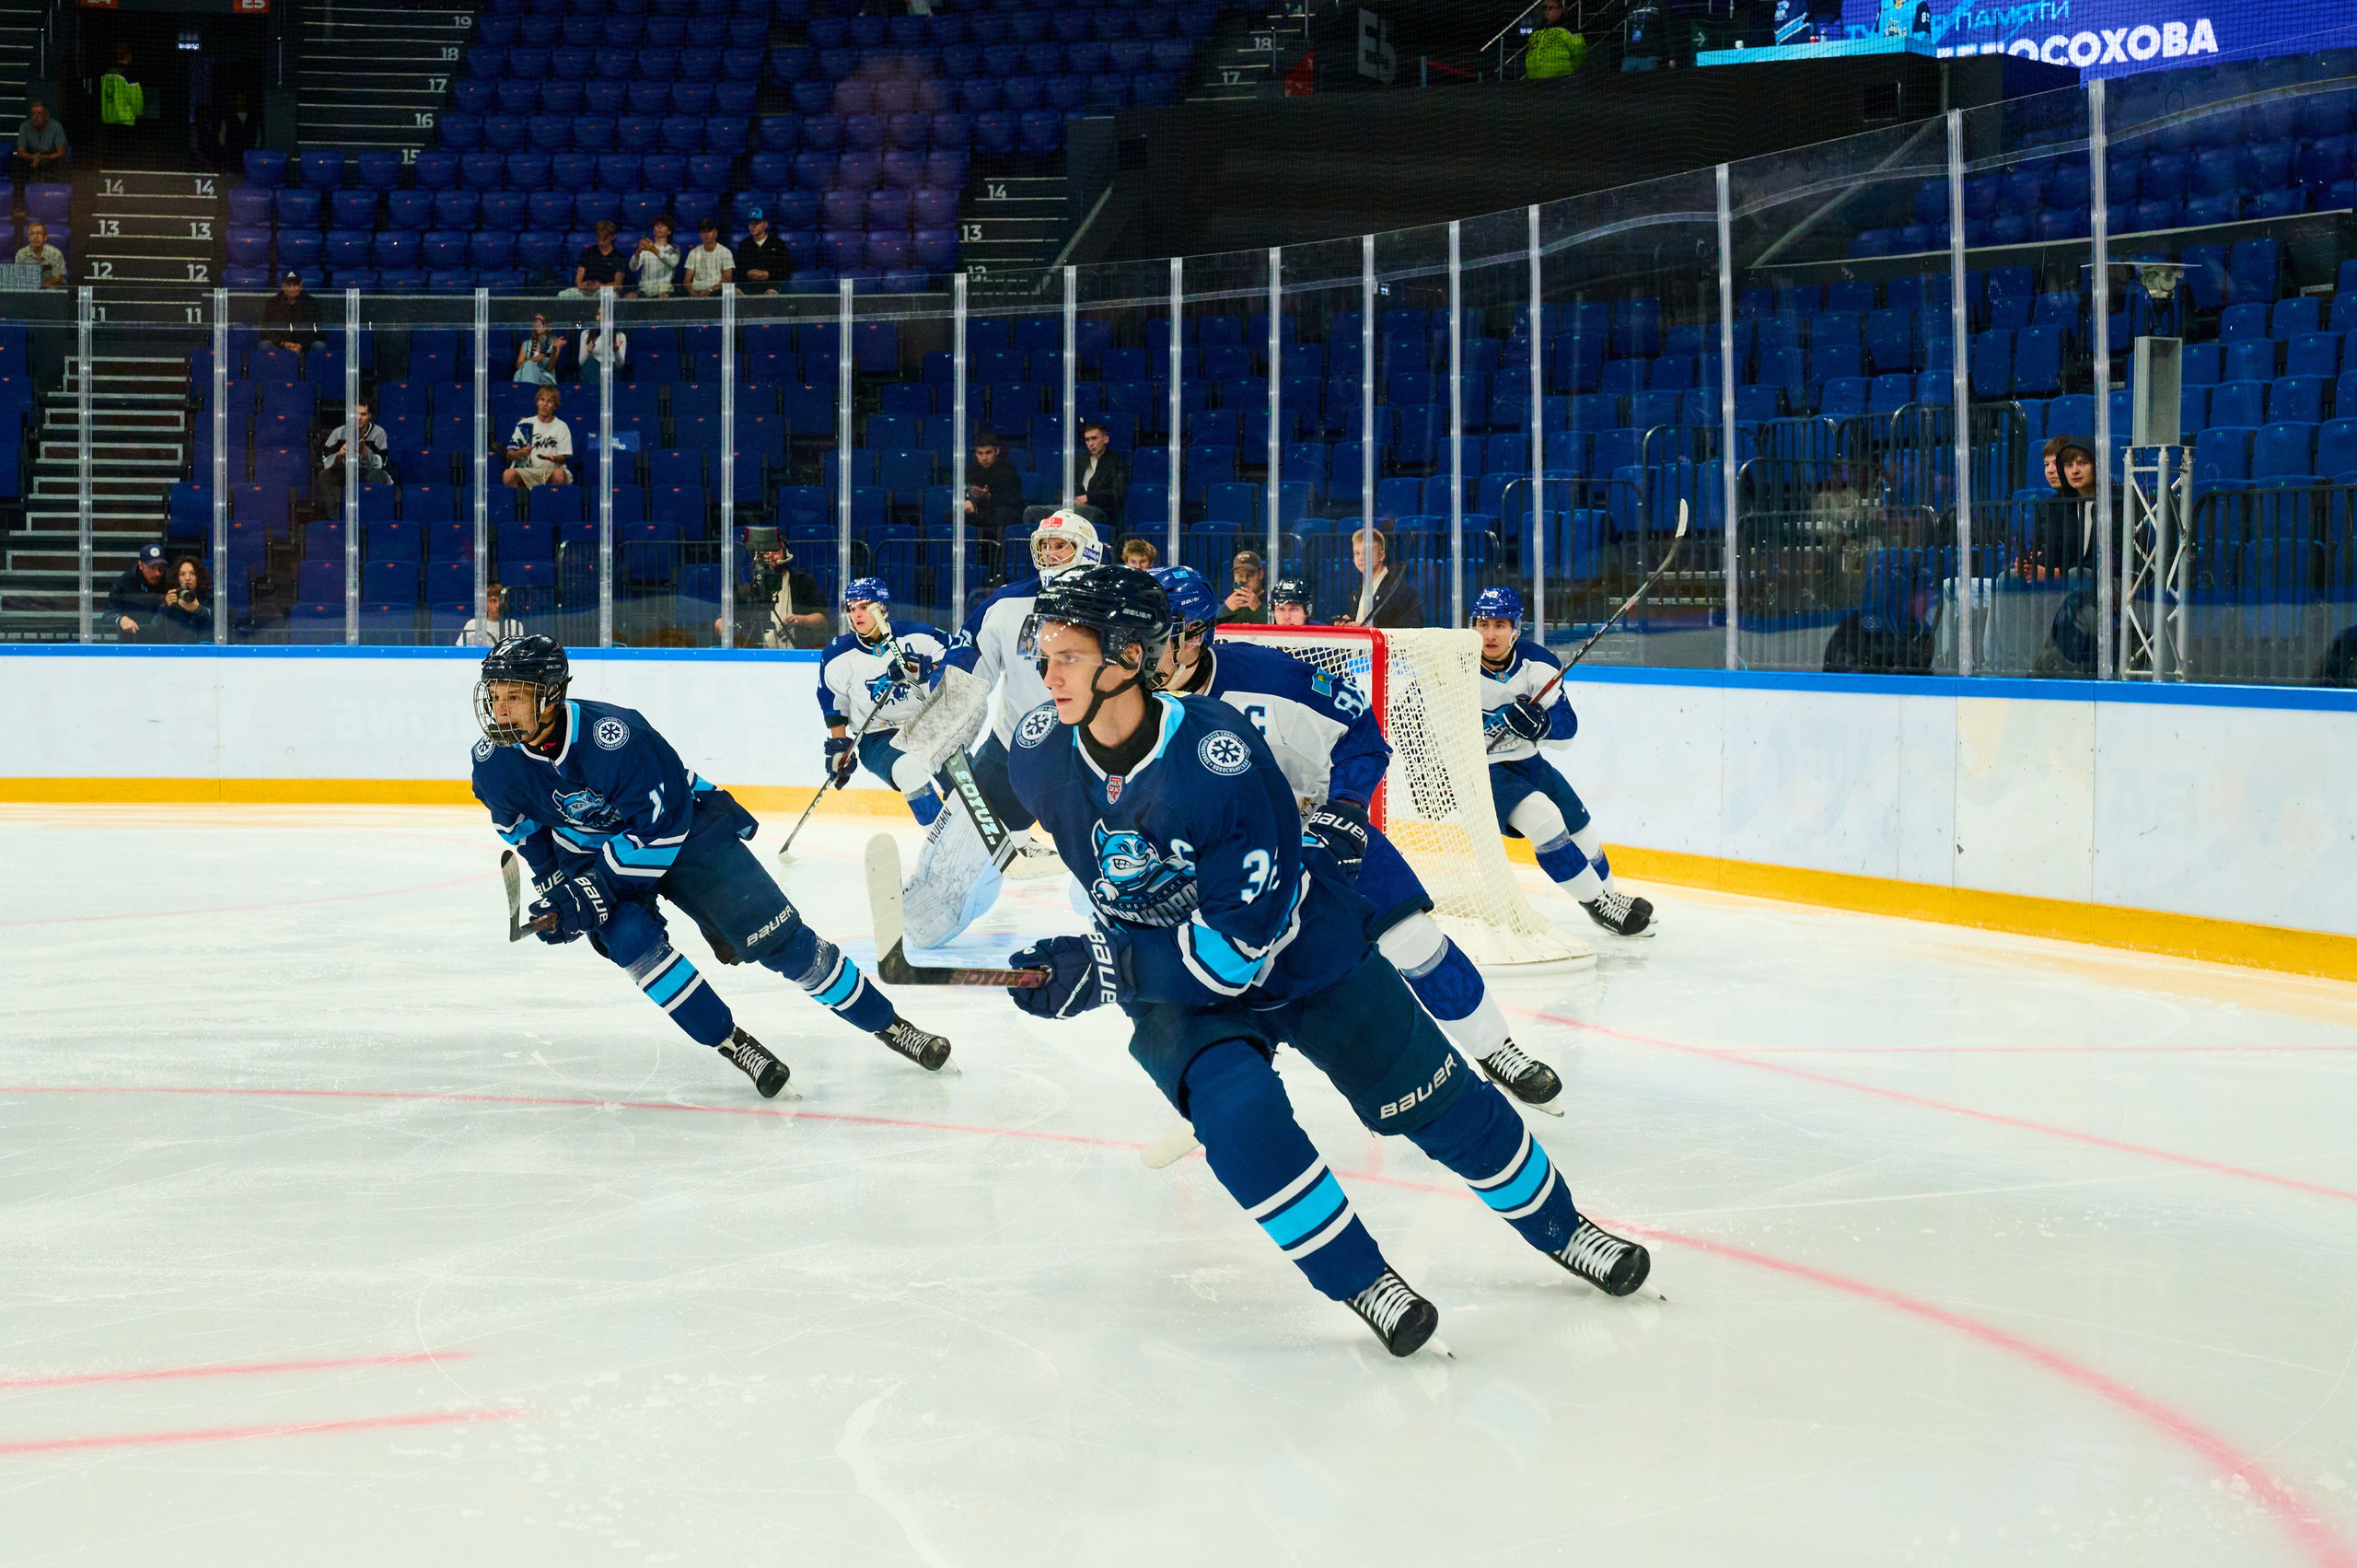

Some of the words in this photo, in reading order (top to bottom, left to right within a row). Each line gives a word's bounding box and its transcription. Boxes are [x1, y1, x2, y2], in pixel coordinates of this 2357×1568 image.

[454, 17, 472, 28] 19
[1956, 1, 2069, 31] ПАМЯТИ
[1254, 37, 1271, 50] 18
[440, 47, 459, 61] 18
[428, 78, 447, 92] 17
[1221, 71, 1240, 84] 17
[414, 112, 434, 128] 16
[104, 179, 124, 194] 14
[194, 179, 215, 195] 14
[988, 184, 1007, 199] 14
[99, 219, 120, 237] 13
[190, 222, 212, 239] 13
[961, 225, 982, 241] 13
[91, 261, 113, 278] 12
[187, 263, 208, 281] 12
[185, 308, 202, 323] 11
[927, 807, 953, 845] VAUGHN
[574, 877, 609, 926] BAUE
[747, 905, 794, 947] BAUER
[1087, 930, 1117, 1005] BAUE
[1381, 1053, 1457, 1120] BAUER
